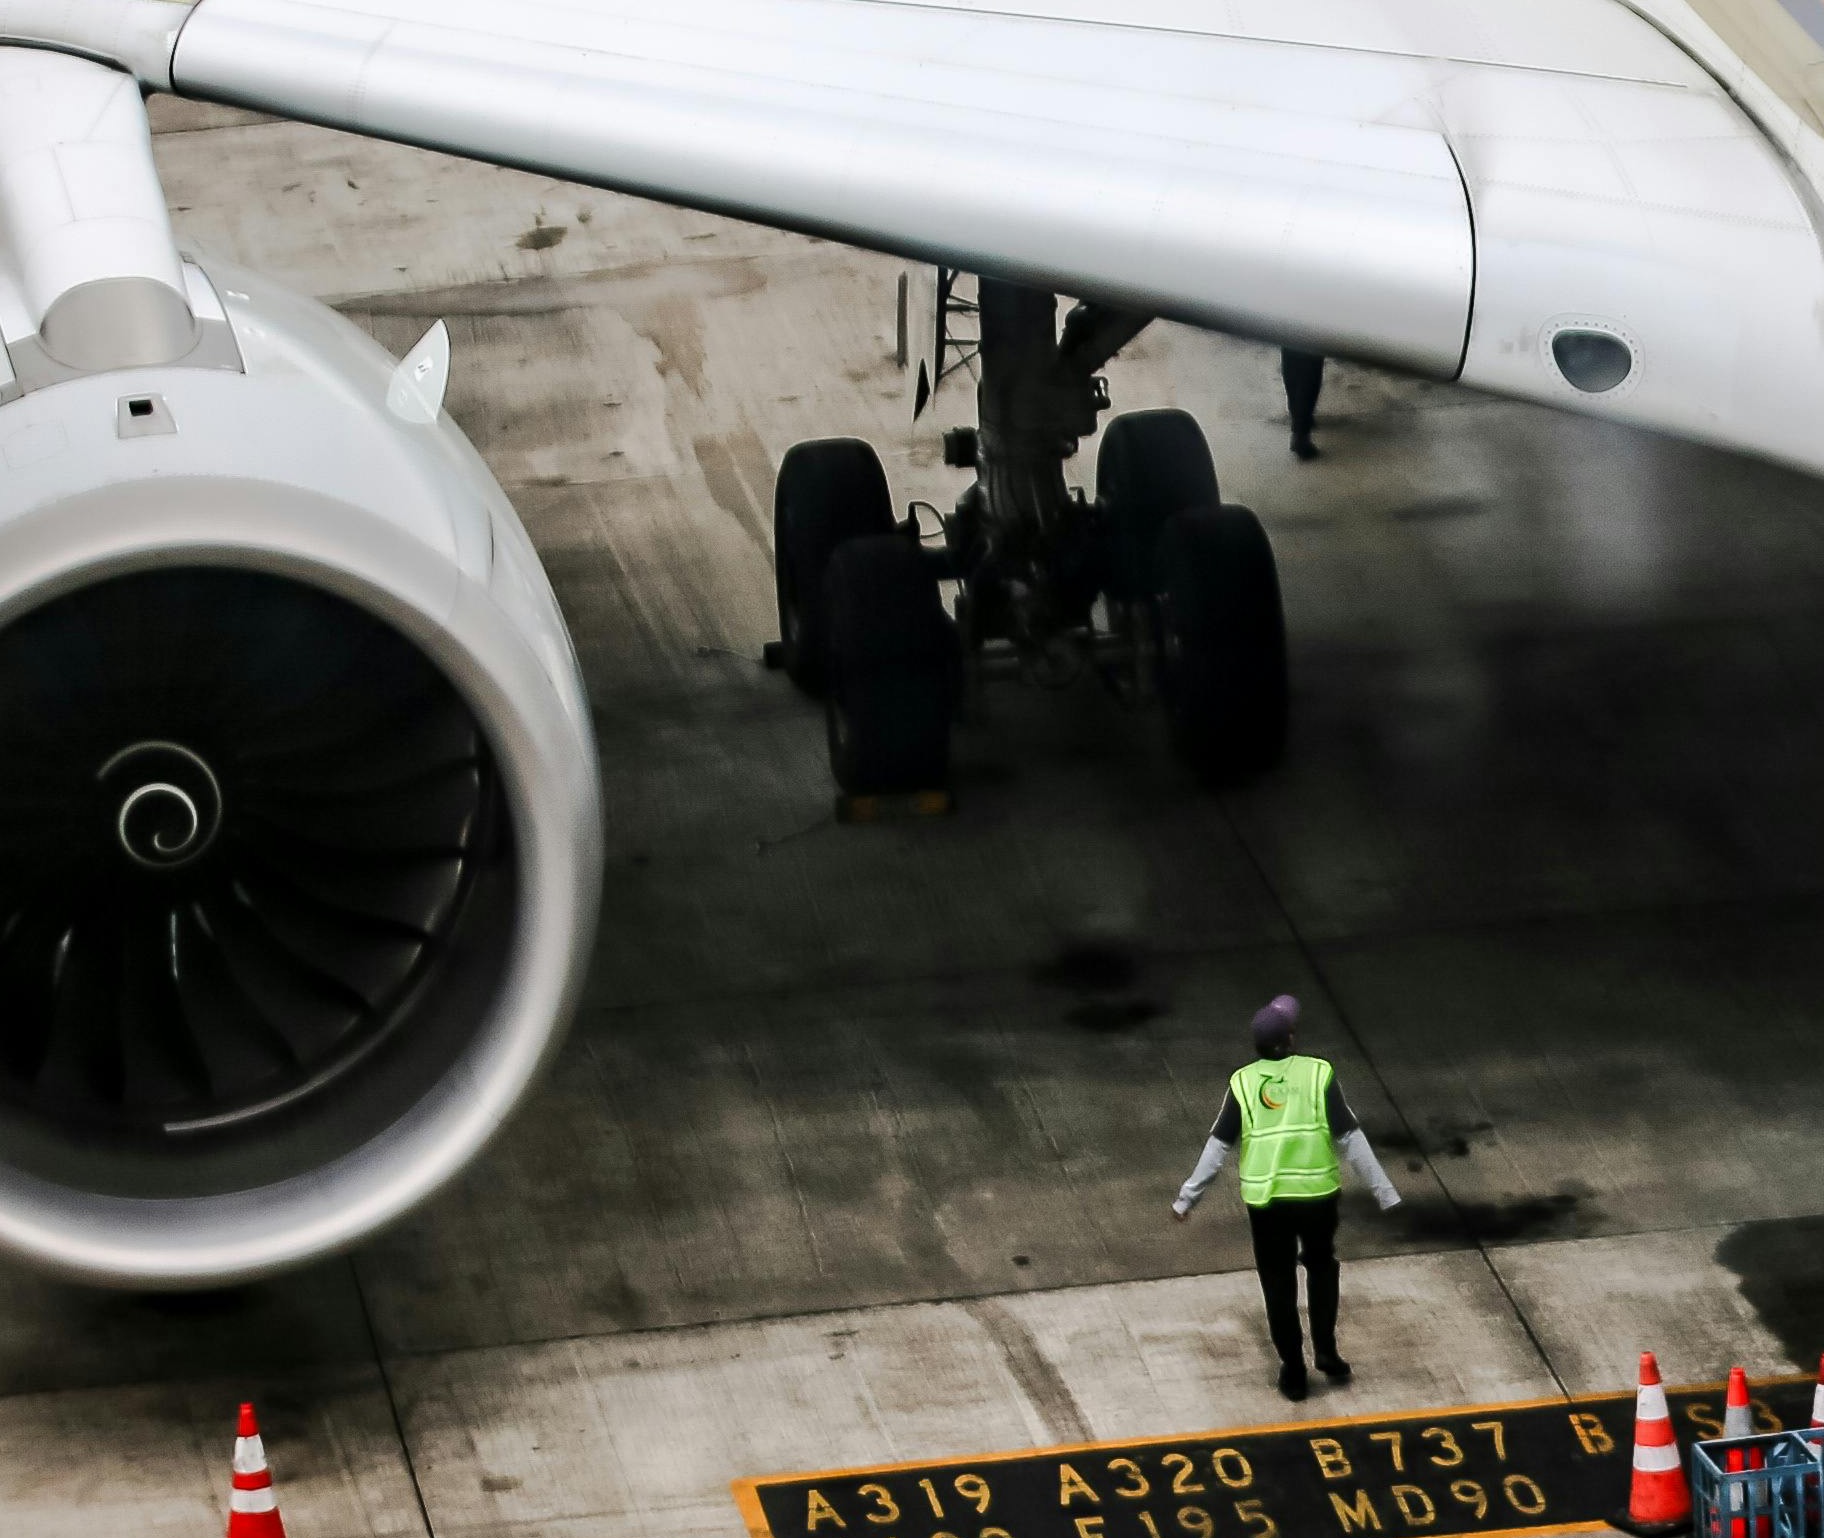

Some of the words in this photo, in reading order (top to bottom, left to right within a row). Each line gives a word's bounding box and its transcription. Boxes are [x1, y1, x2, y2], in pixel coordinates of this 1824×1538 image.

[806, 1473, 992, 1531] A319
[1059, 1447, 1254, 1506] A320
[1309, 1421, 1507, 1480] B737
[1328, 1474, 1547, 1534] MD90
